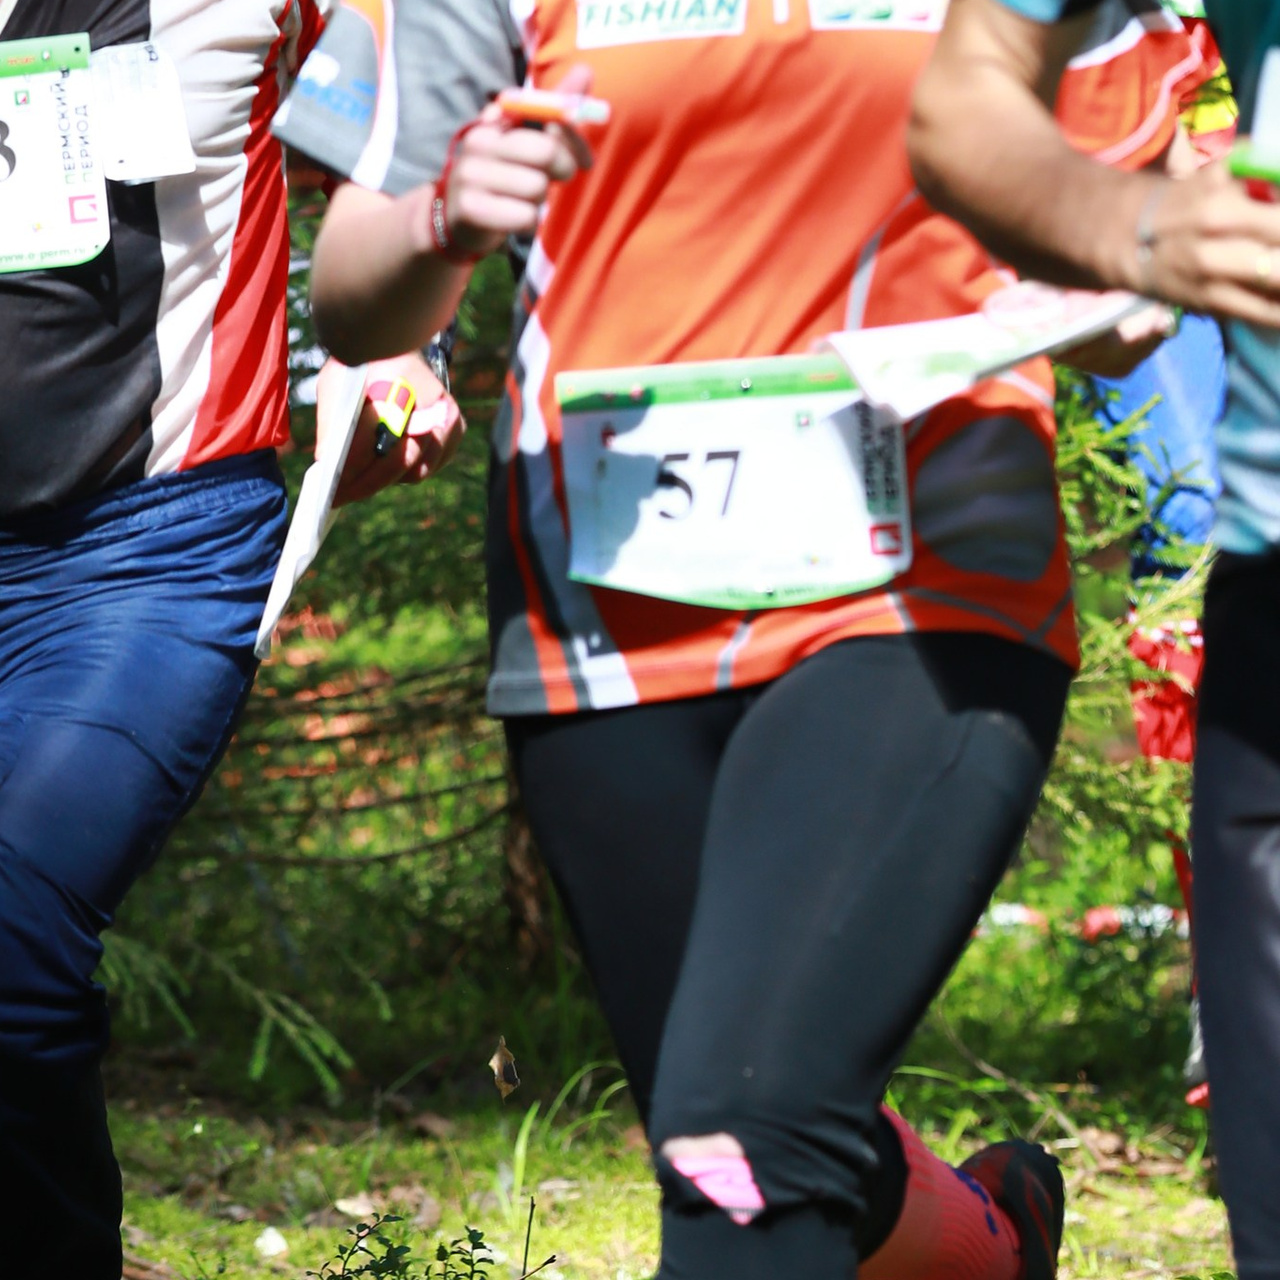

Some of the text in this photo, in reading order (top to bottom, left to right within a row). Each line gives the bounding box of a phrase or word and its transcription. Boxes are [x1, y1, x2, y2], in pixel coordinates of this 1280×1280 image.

[50, 80, 76, 185] ПЕРМСКИЙ
[74, 104, 93, 184] ПЕРИОД
[656, 450, 741, 520] 57
